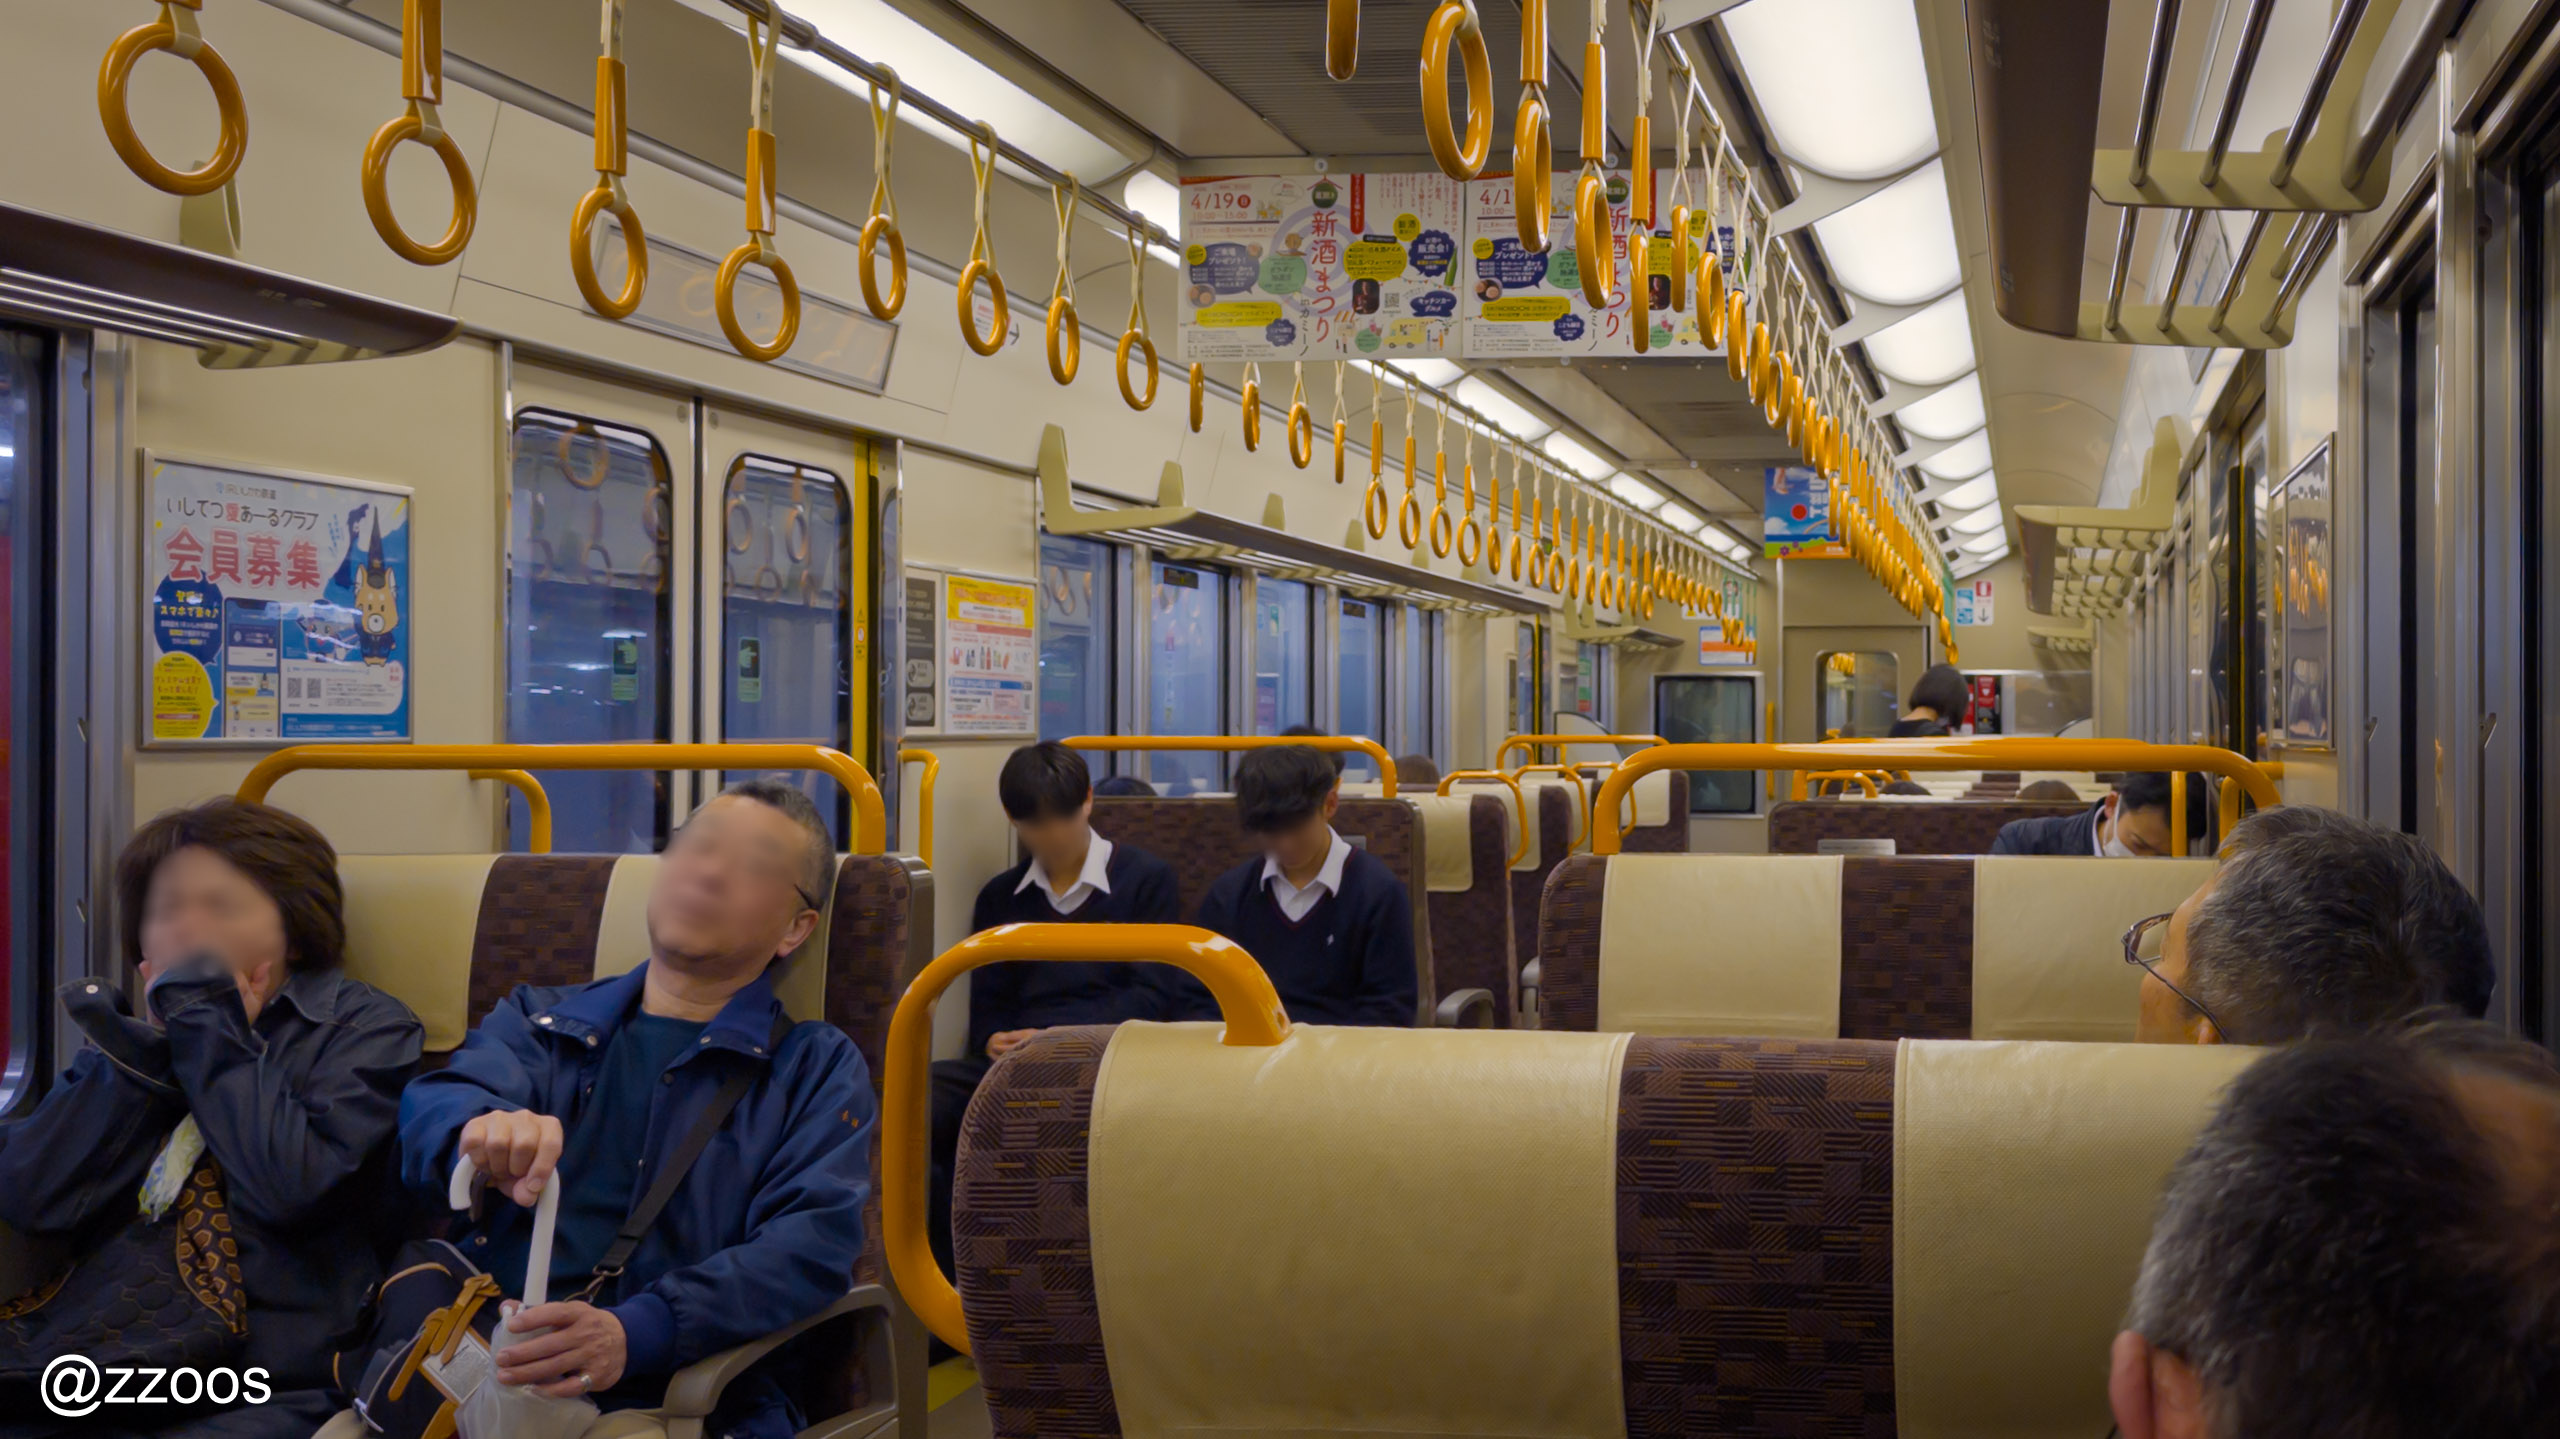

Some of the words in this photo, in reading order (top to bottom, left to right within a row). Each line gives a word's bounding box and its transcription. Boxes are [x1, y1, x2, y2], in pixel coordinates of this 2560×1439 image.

[1191, 192, 1234, 210] 4/19
[1311, 210, 1338, 343] 新酒まつり
[166, 527, 321, 590] 会員募集
